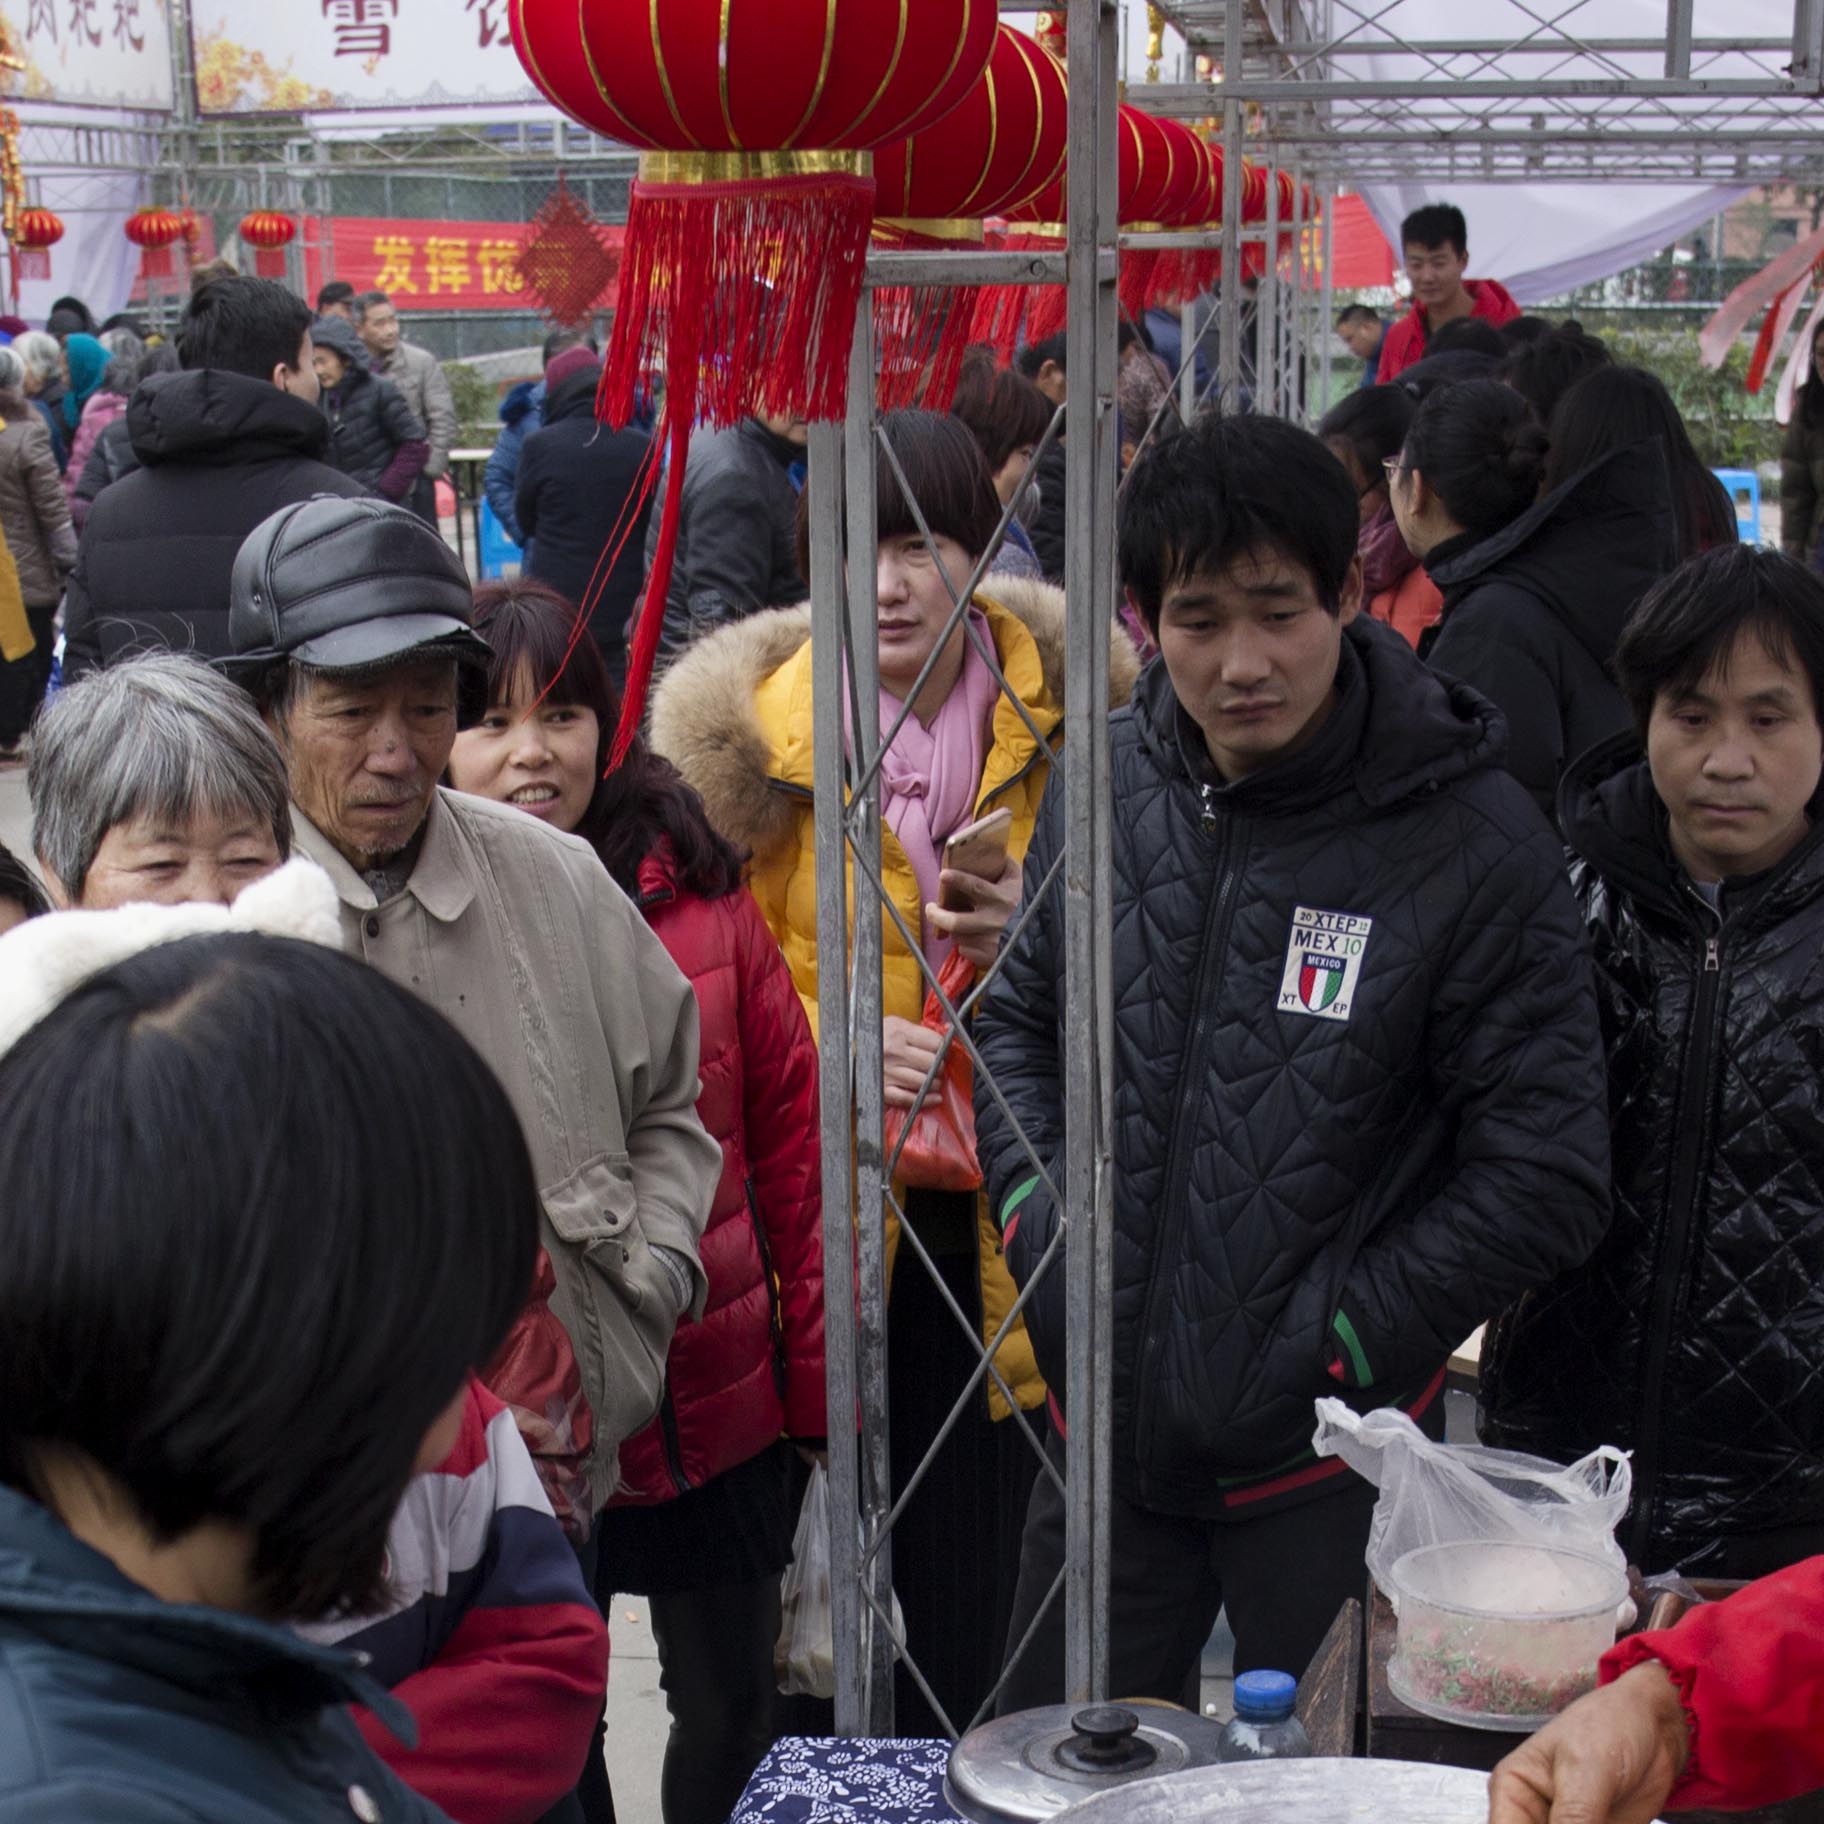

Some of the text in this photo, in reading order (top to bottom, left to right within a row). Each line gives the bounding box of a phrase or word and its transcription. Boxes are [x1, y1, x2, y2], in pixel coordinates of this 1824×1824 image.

[1314, 912, 1358, 933] XTEP
[1294, 929, 1362, 955] MEX 10
[1307, 954, 1341, 969] MEXICO
[1281, 993, 1297, 1005] XT
[1332, 1002, 1348, 1014] EP
